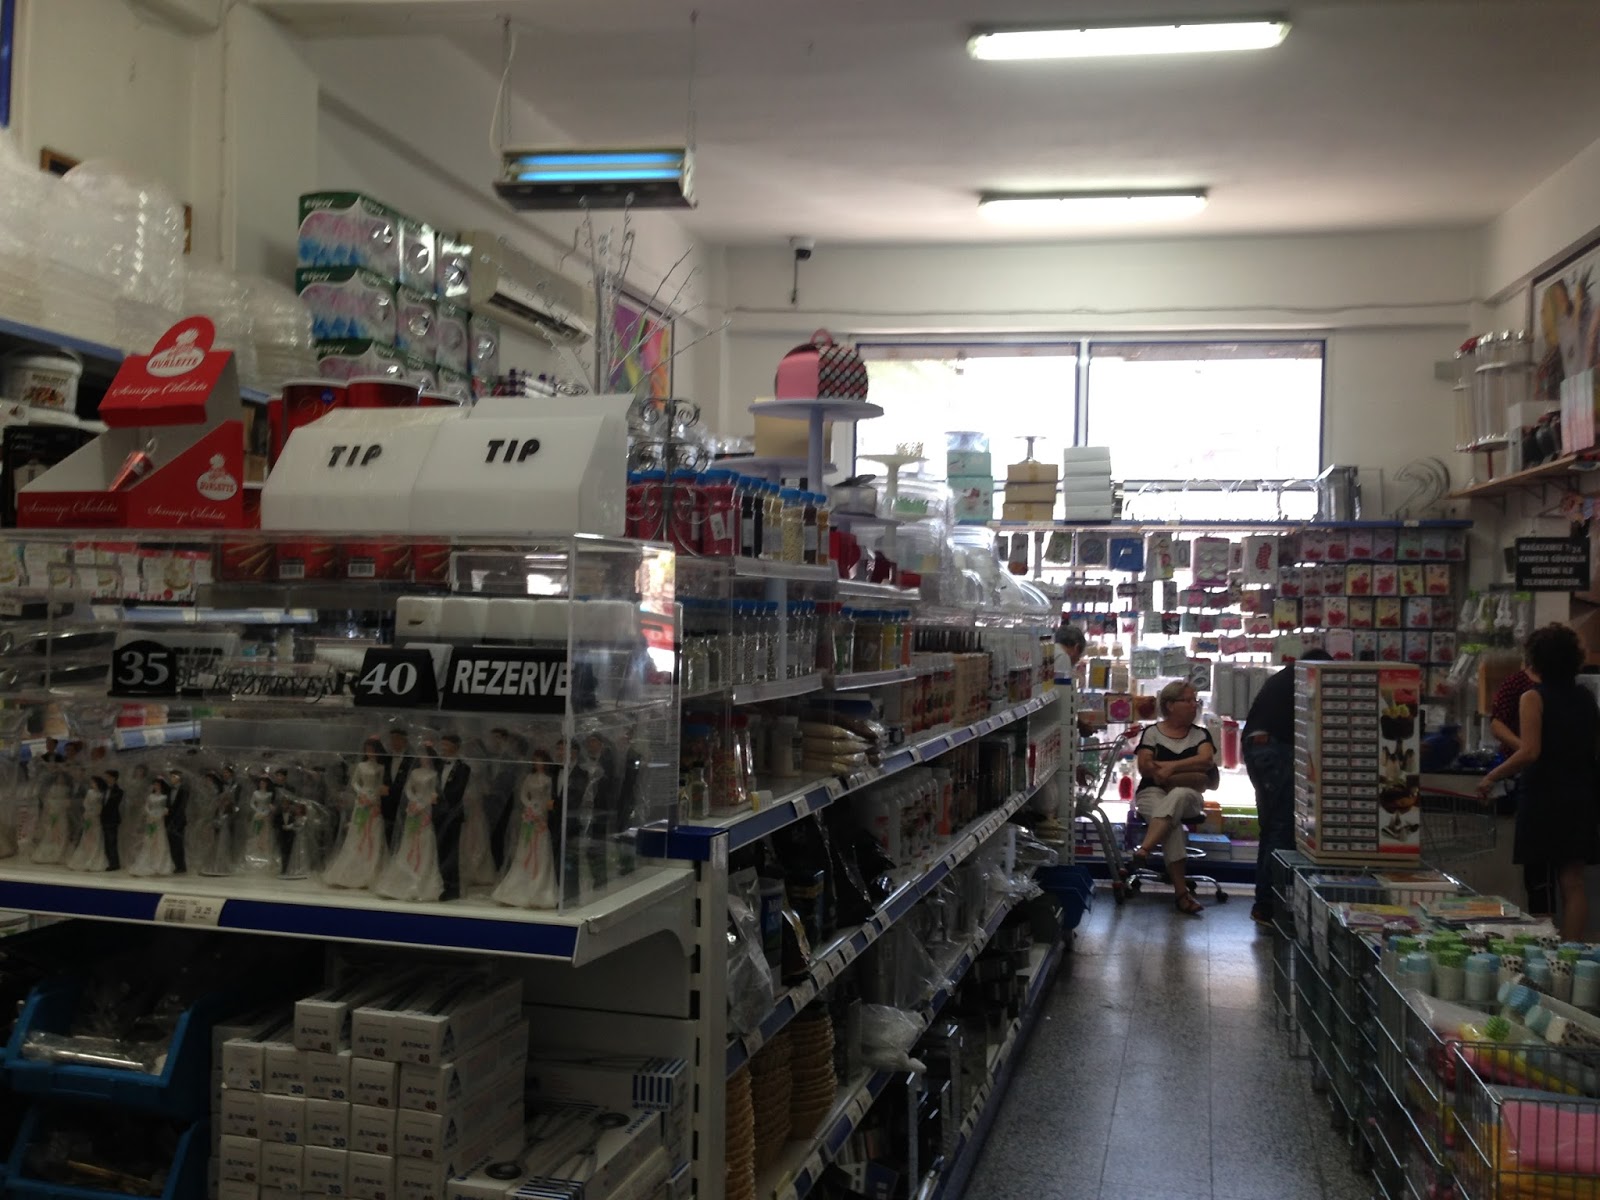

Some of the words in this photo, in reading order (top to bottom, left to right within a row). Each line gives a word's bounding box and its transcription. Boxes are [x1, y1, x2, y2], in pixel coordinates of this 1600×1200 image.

[151, 356, 199, 370] OVALETTE
[328, 444, 383, 467] TIP
[484, 439, 541, 464] TIP
[118, 650, 169, 686] 35
[360, 662, 417, 696] 40
[331, 1089, 345, 1100] 30
